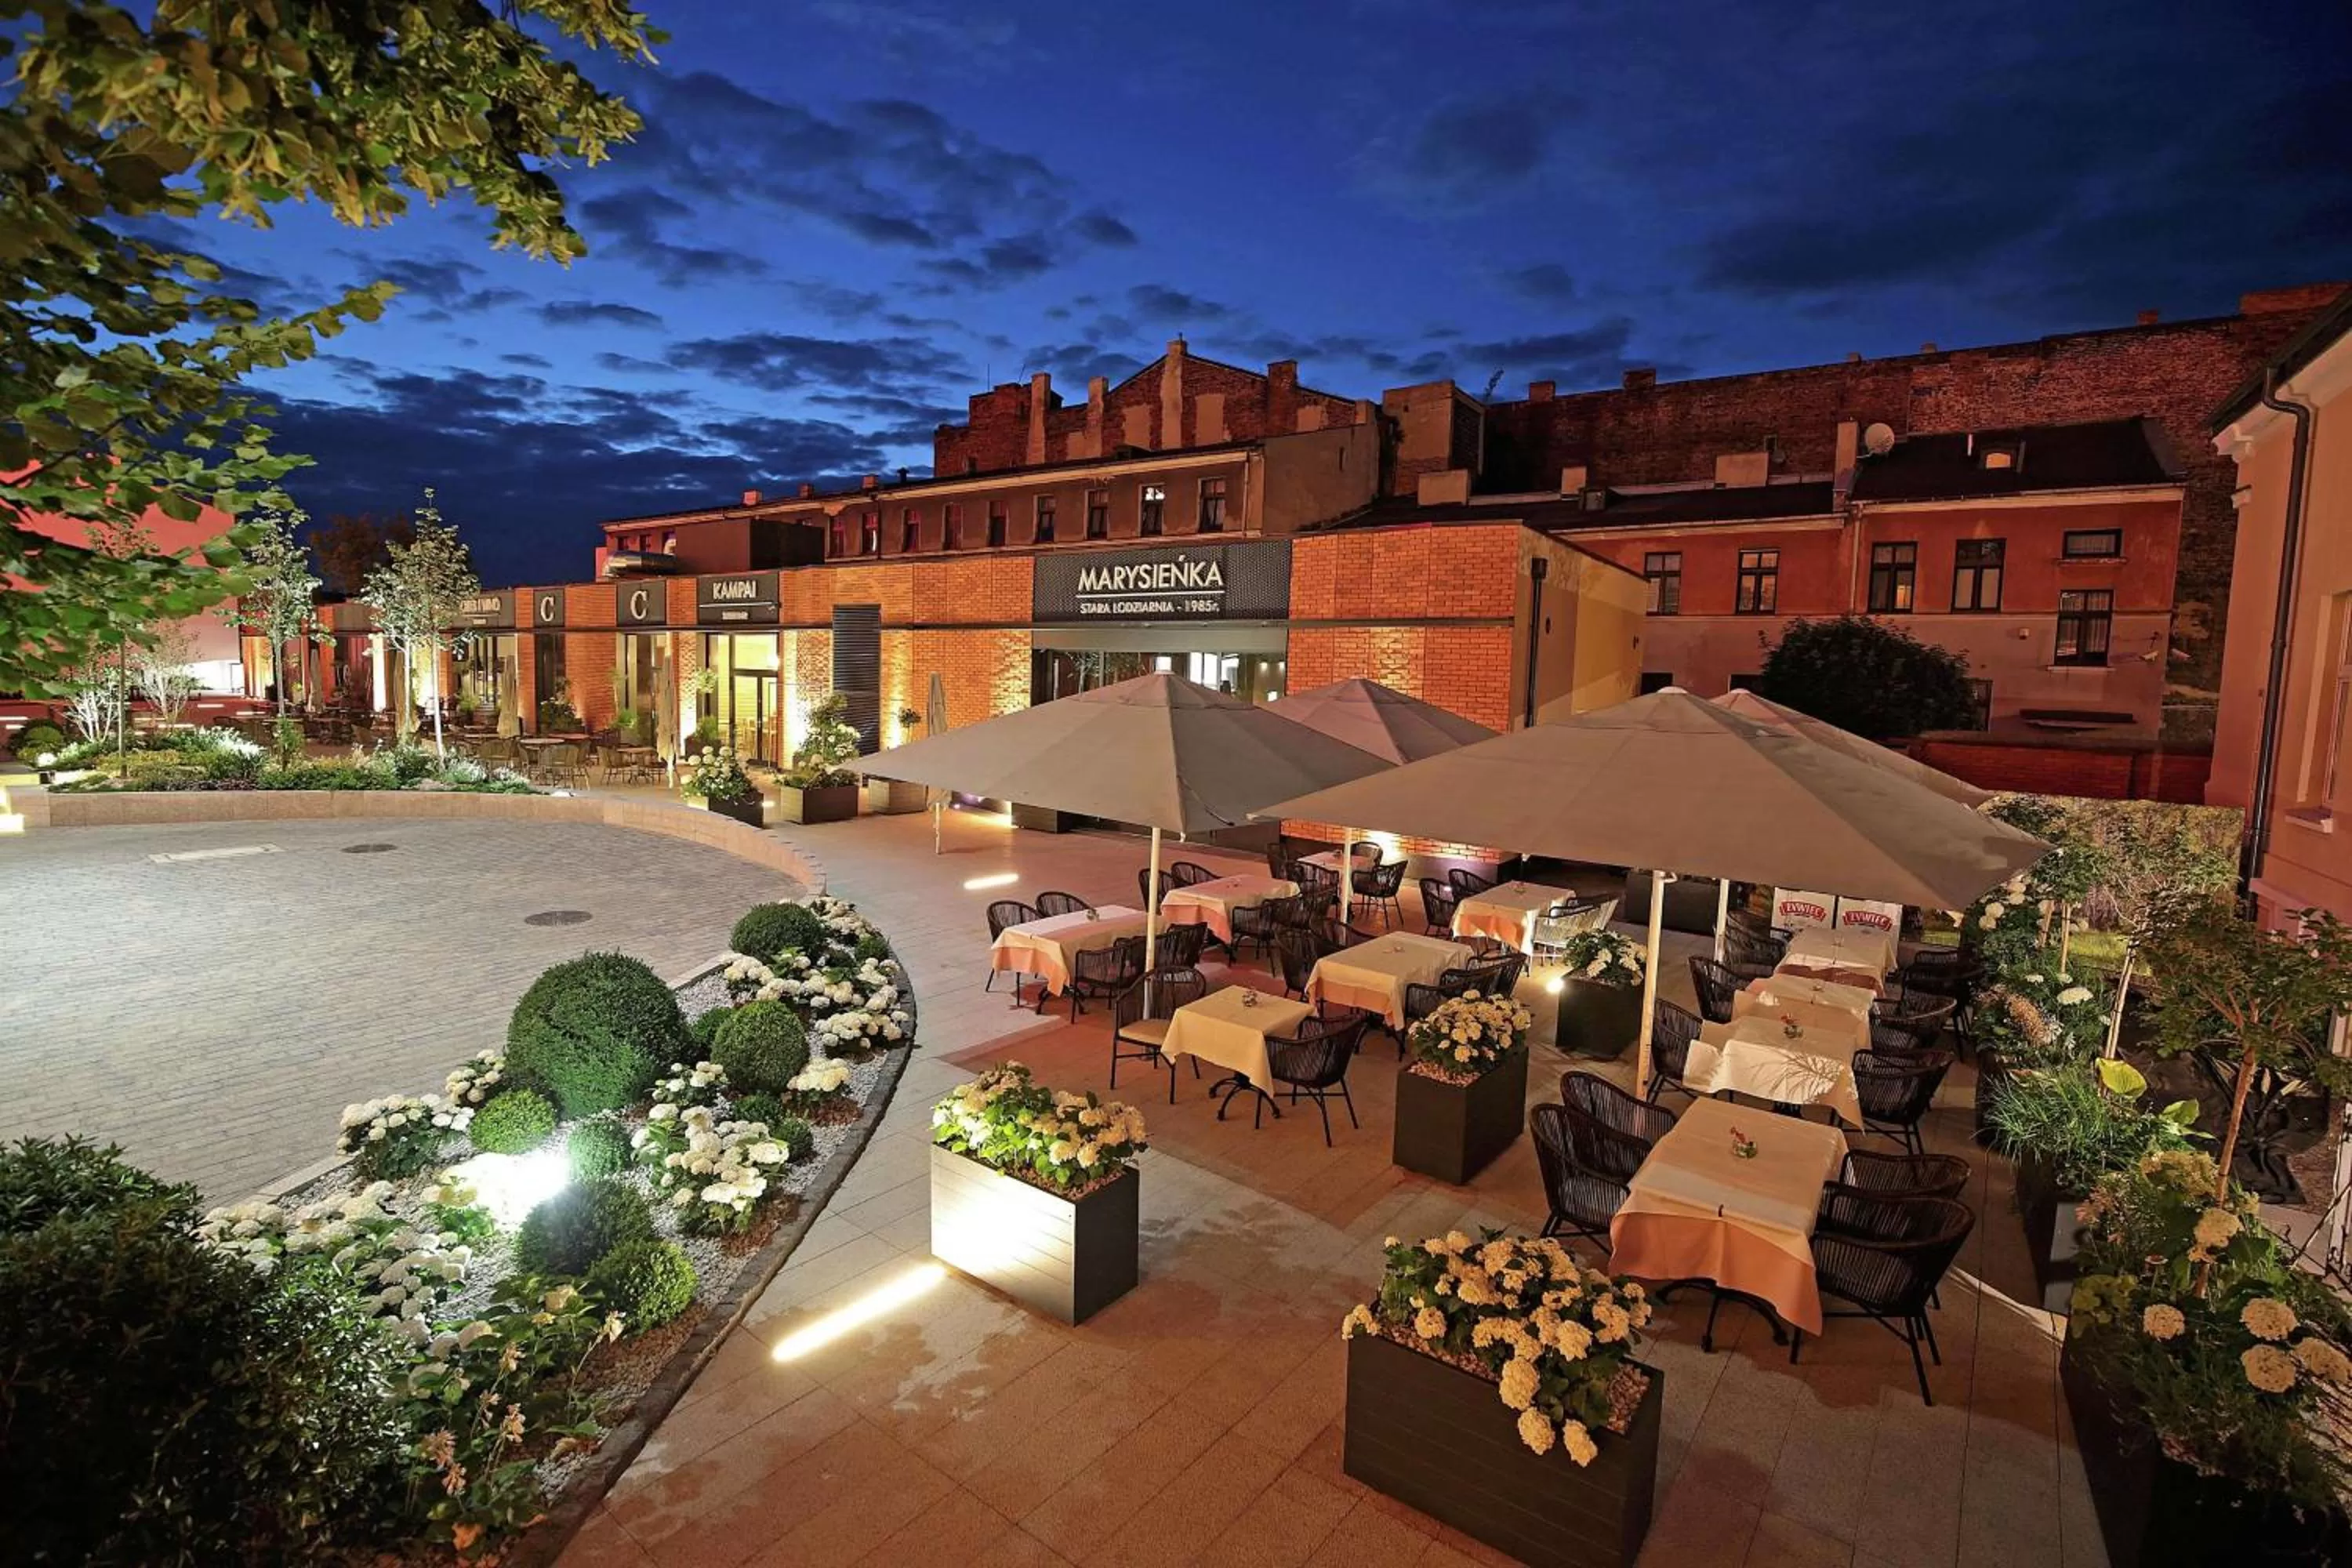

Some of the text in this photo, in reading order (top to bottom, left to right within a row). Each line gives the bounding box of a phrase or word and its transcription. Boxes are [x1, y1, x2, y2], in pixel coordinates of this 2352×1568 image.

[1078, 554, 1224, 591] MARYSIEŃKA
[712, 580, 757, 600] KAMPAI
[540, 597, 554, 622] C
[630, 590, 648, 620] C
[1080, 603, 1111, 614] STARA
